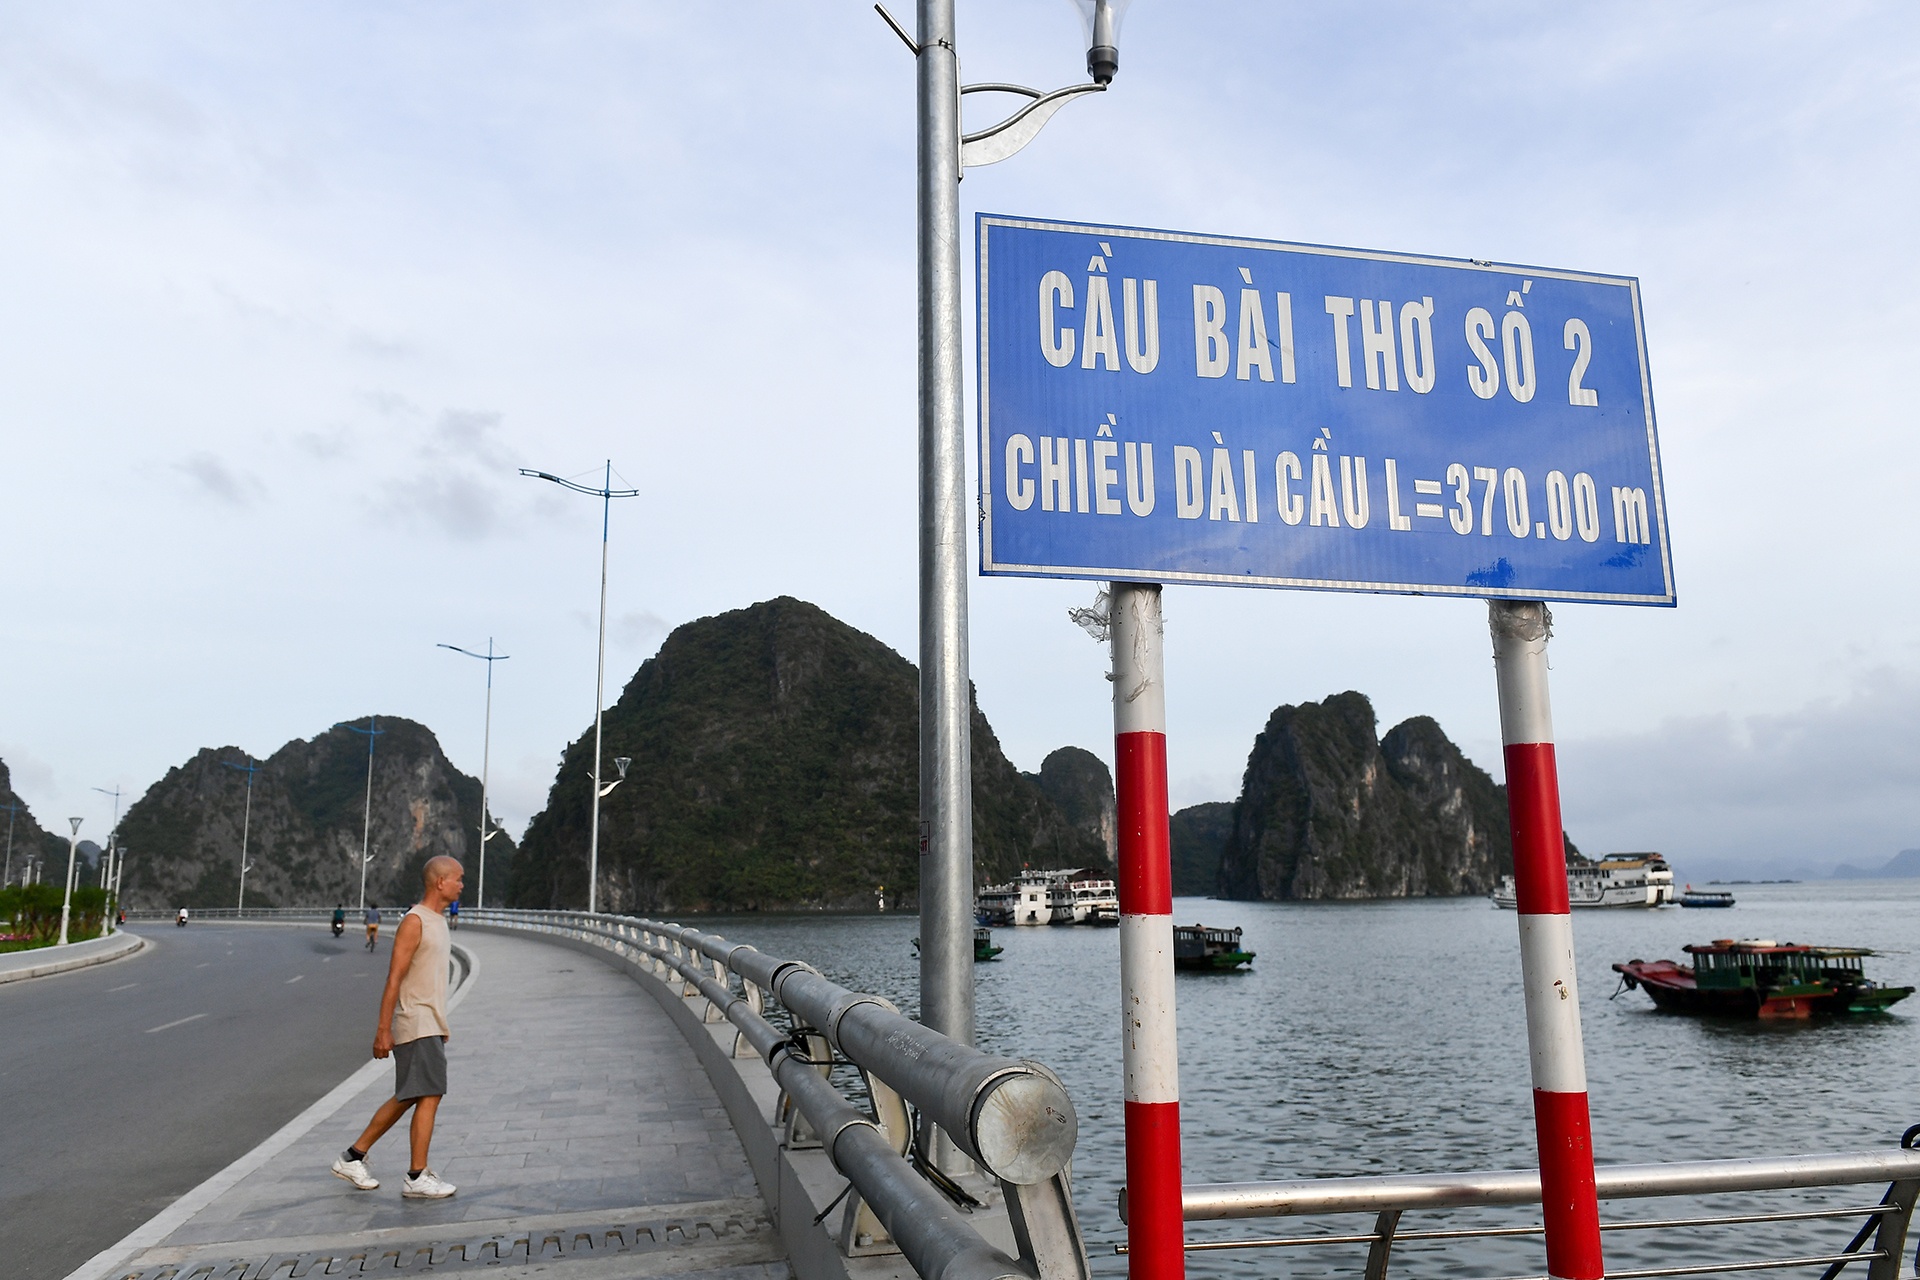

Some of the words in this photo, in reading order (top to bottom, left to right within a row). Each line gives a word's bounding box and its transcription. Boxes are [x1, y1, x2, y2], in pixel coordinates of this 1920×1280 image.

[1039, 242, 1159, 374] CẦU
[1193, 266, 1296, 384] BÀI
[1325, 295, 1436, 393] THƠ
[1465, 280, 1537, 404] SỐ
[1564, 318, 1599, 407] 2
[1005, 413, 1155, 517] CHIỀU
[1173, 431, 1258, 523] DÀI
[1276, 427, 1369, 530] CẦU
[1611, 486, 1651, 544] m
